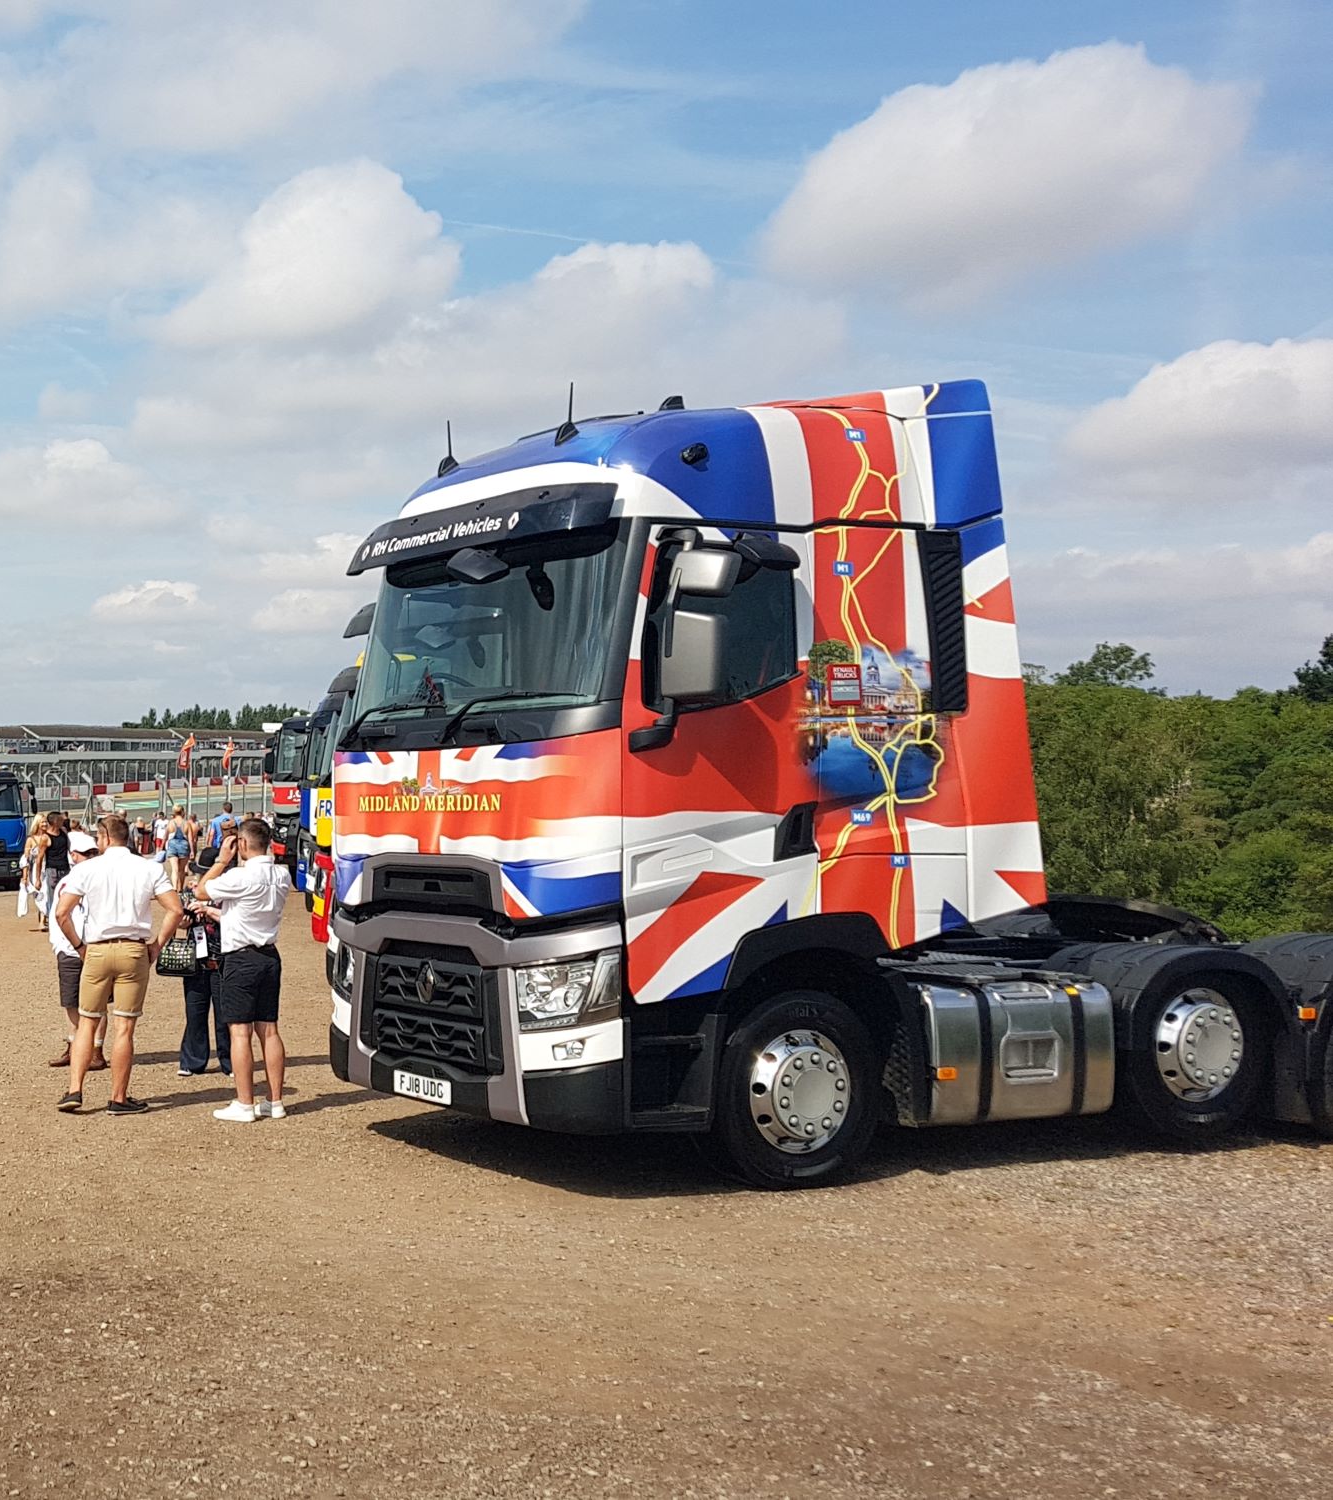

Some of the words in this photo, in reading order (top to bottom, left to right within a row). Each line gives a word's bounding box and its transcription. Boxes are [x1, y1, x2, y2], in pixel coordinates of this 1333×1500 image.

[849, 430, 862, 440] M1
[371, 539, 389, 557] RH
[389, 524, 452, 552] Commercial
[452, 516, 502, 539] Vehicles
[837, 564, 849, 573] M1
[359, 795, 420, 812] MIDLAND
[424, 794, 501, 812] MERIDIAN
[853, 812, 871, 822] M69
[893, 856, 906, 865] M1
[400, 1074, 420, 1094] FJ18
[422, 1079, 443, 1099] UDG
